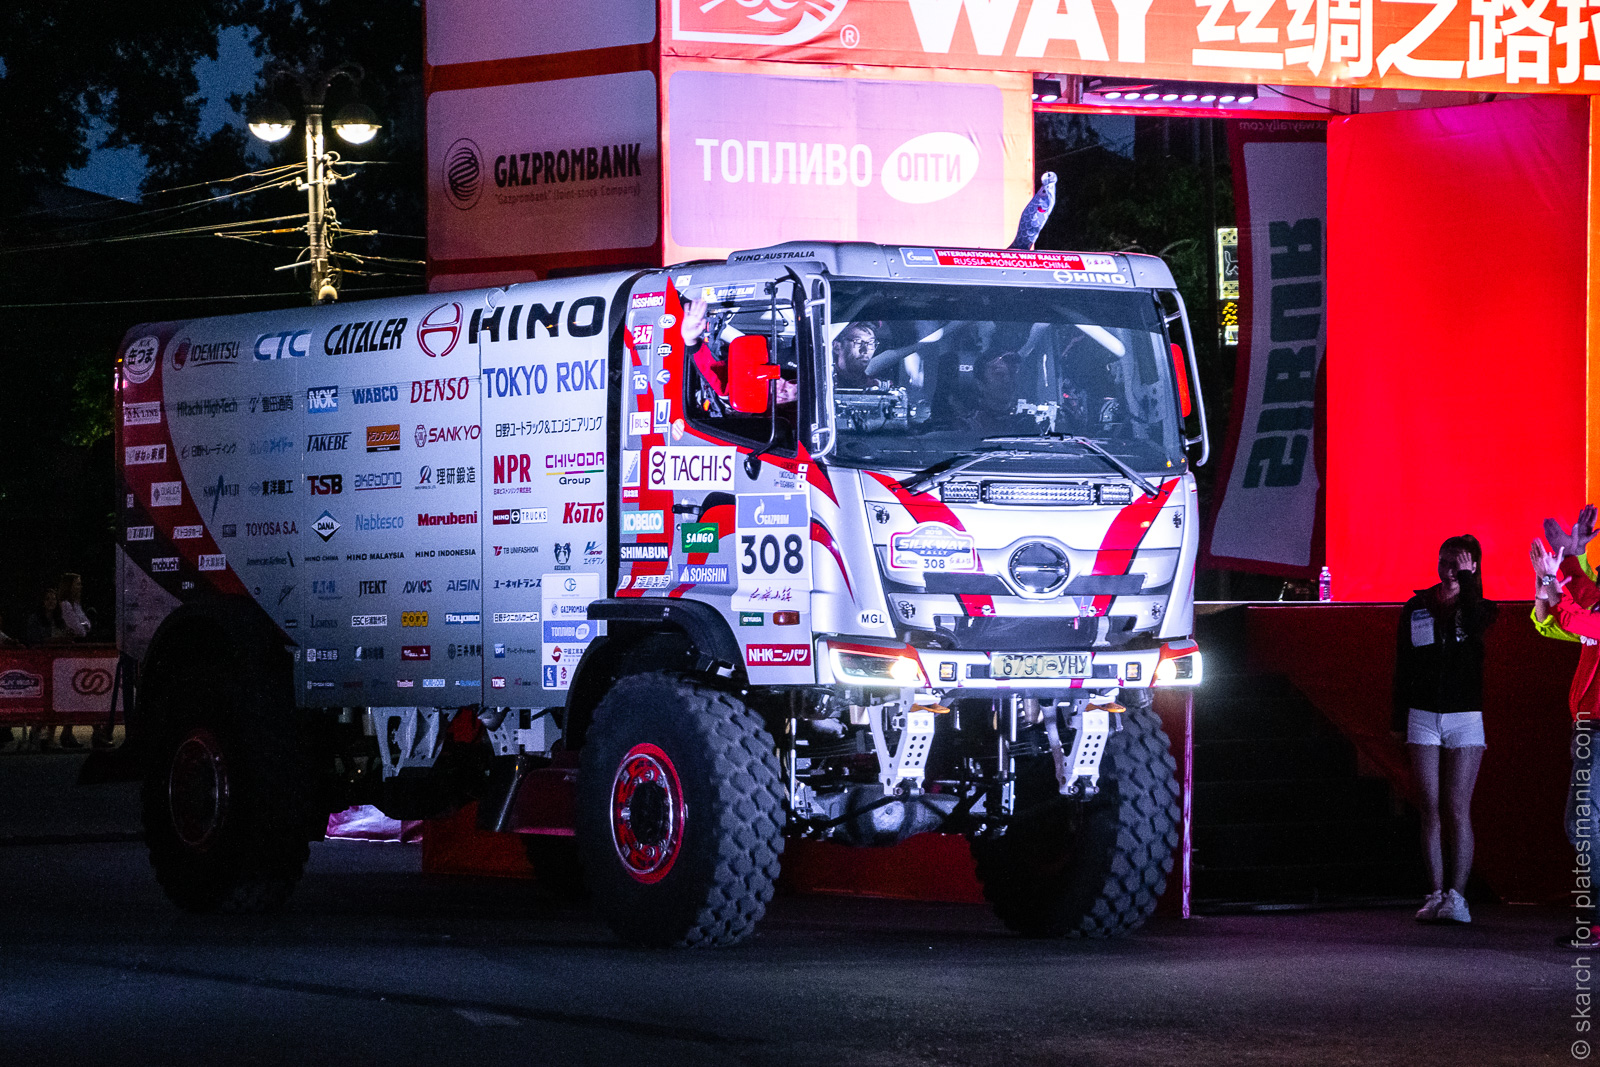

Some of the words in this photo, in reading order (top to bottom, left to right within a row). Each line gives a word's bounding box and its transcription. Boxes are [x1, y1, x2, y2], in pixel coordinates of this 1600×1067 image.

[908, 0, 1155, 63] WAY
[494, 143, 641, 188] GAZPROMBANK
[695, 138, 872, 188] ТОПЛИВО
[897, 151, 961, 183] ОПТИ
[764, 251, 815, 260] AUSTRALIA
[938, 250, 1000, 259] INTERNATIONAL
[1000, 252, 1019, 260] SILK
[1074, 271, 1127, 284] HINO
[468, 296, 607, 344] HINO
[254, 330, 312, 361] CTC
[324, 318, 408, 356] CATALER
[190, 341, 240, 362] IDEMITSU
[482, 364, 548, 399] TOKYO
[556, 358, 606, 393] ROKI
[308, 388, 338, 410] NOK
[352, 385, 399, 405] WABCO
[410, 376, 469, 404] DENSO
[177, 400, 202, 419] Hitachi
[307, 431, 351, 452] TAKEBE
[428, 424, 481, 443] SANKYO
[493, 453, 531, 484] NPR
[545, 451, 605, 469] CHIYODA
[671, 455, 732, 482] TACHI-S
[355, 472, 402, 487] akebono
[436, 466, 476, 485] 理研鍛造
[559, 476, 591, 486] Group
[355, 513, 404, 531] Nabtesco
[418, 510, 478, 526] Marubeni
[493, 513, 510, 521] HINO
[522, 510, 547, 521] TRUCKS
[623, 513, 662, 531] KOBELCO
[764, 514, 790, 525] GAZPROM
[246, 522, 282, 537] TOYOSA
[284, 521, 299, 536] S.A.
[317, 521, 335, 531] DANA
[686, 533, 714, 543] SANGO
[898, 539, 936, 550] SILK
[935, 539, 968, 551] WAY
[346, 553, 367, 561] HINO
[370, 552, 405, 560] MALAYSIA
[415, 550, 436, 558] HINO
[438, 549, 476, 557] INDONESIA
[503, 547, 511, 555] TB
[511, 546, 539, 555] UNIFASHION
[621, 546, 668, 560] SHIMABUN
[741, 534, 804, 574] 308
[924, 557, 946, 570] 308
[494, 578, 542, 589] ユーネットランス
[690, 567, 727, 583] SOHSHIN
[358, 580, 387, 598] JTEKT
[446, 579, 480, 592] AISIN
[861, 614, 885, 624] MGL
[1003, 655, 1045, 675] 6790
[1058, 655, 1088, 675] УНУ
